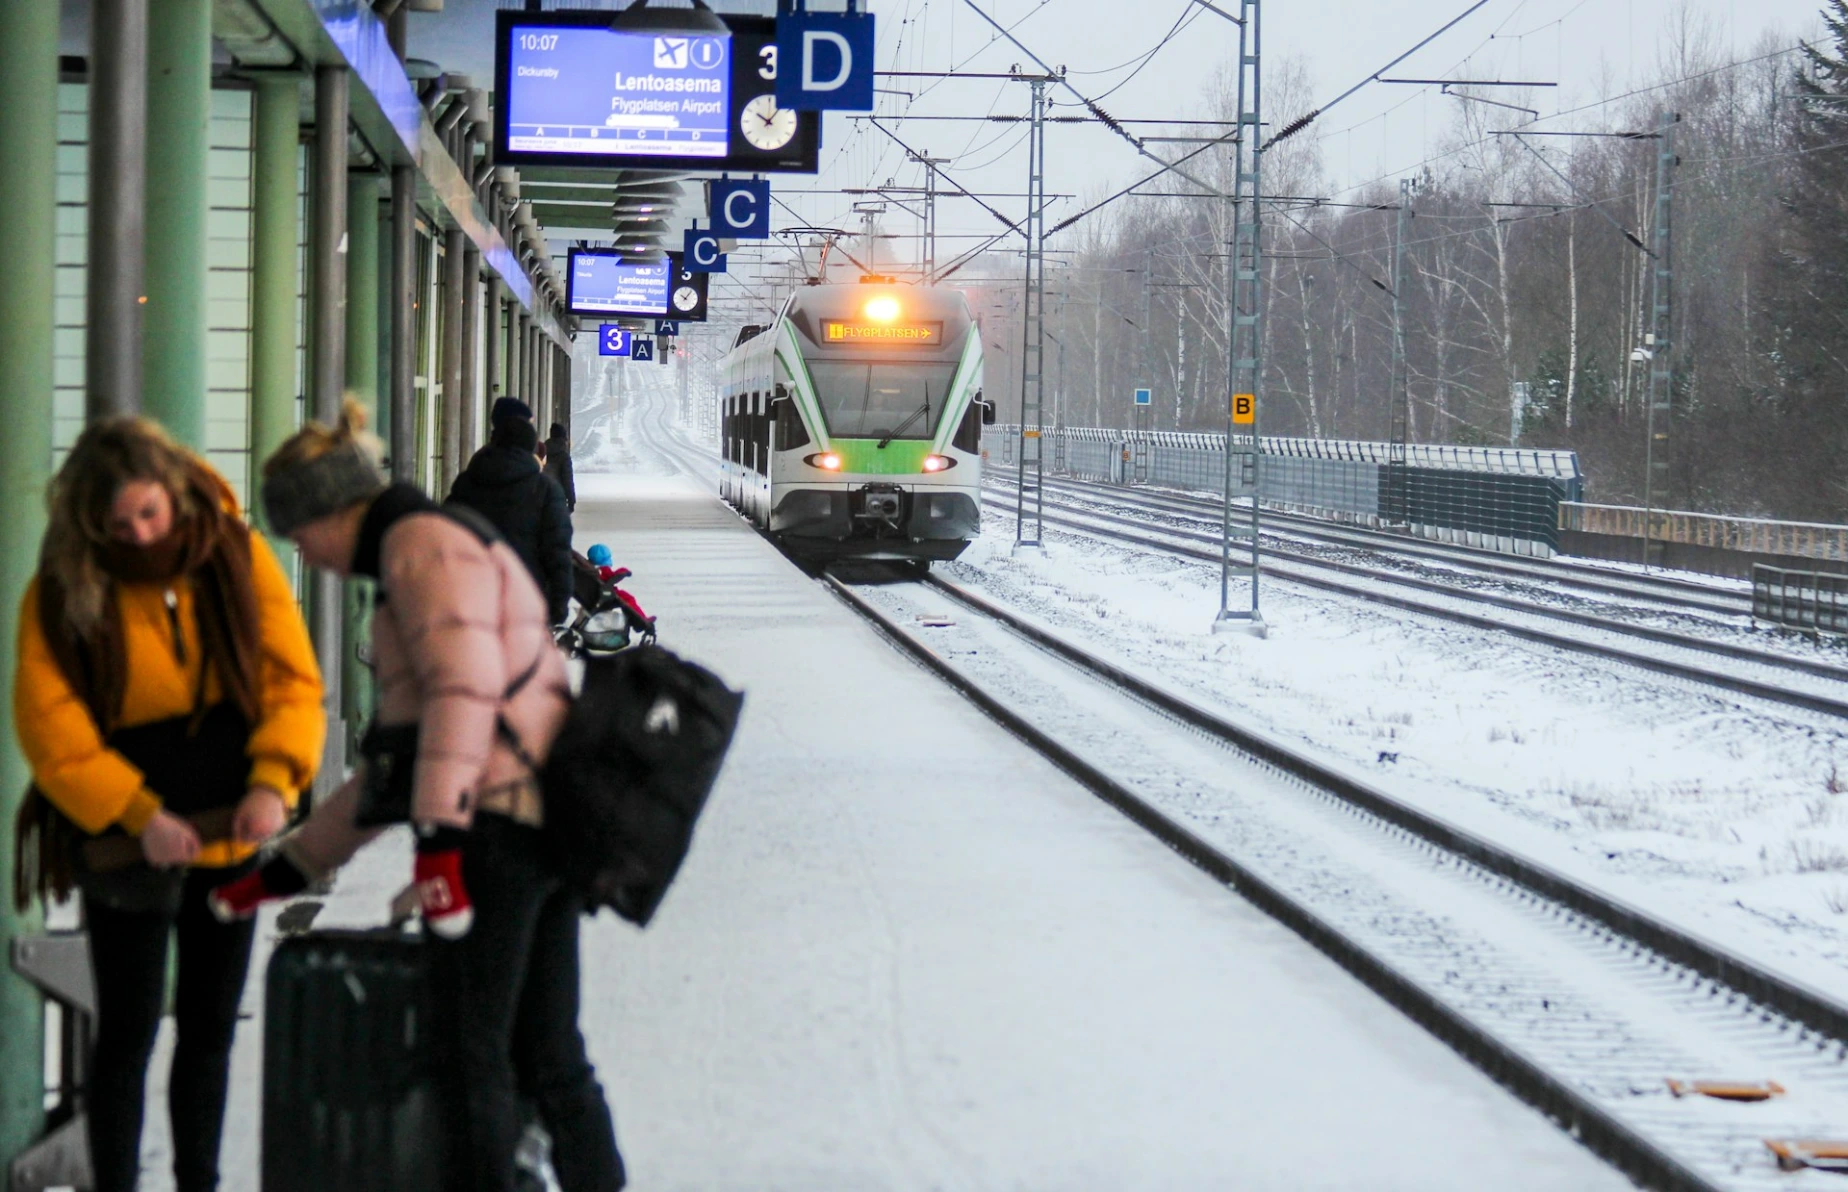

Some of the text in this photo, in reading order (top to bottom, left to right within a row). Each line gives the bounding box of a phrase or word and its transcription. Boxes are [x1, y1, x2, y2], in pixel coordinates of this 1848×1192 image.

[520, 34, 558, 50] 10:07
[759, 45, 778, 80] 3
[802, 31, 851, 91] D
[615, 72, 721, 93] Lentoasema
[611, 96, 722, 116] Flygplatsen Airport
[535, 127, 701, 141] A B C D
[724, 190, 756, 228] C
[694, 237, 717, 265] C
[578, 258, 595, 267] 10:07
[618, 275, 666, 286] Lentoasema
[660, 320, 674, 332] A
[844, 327, 919, 338] FLYGPLATSEN
[607, 328, 623, 350] 3
[636, 344, 649, 357] A
[1236, 397, 1251, 415] B
